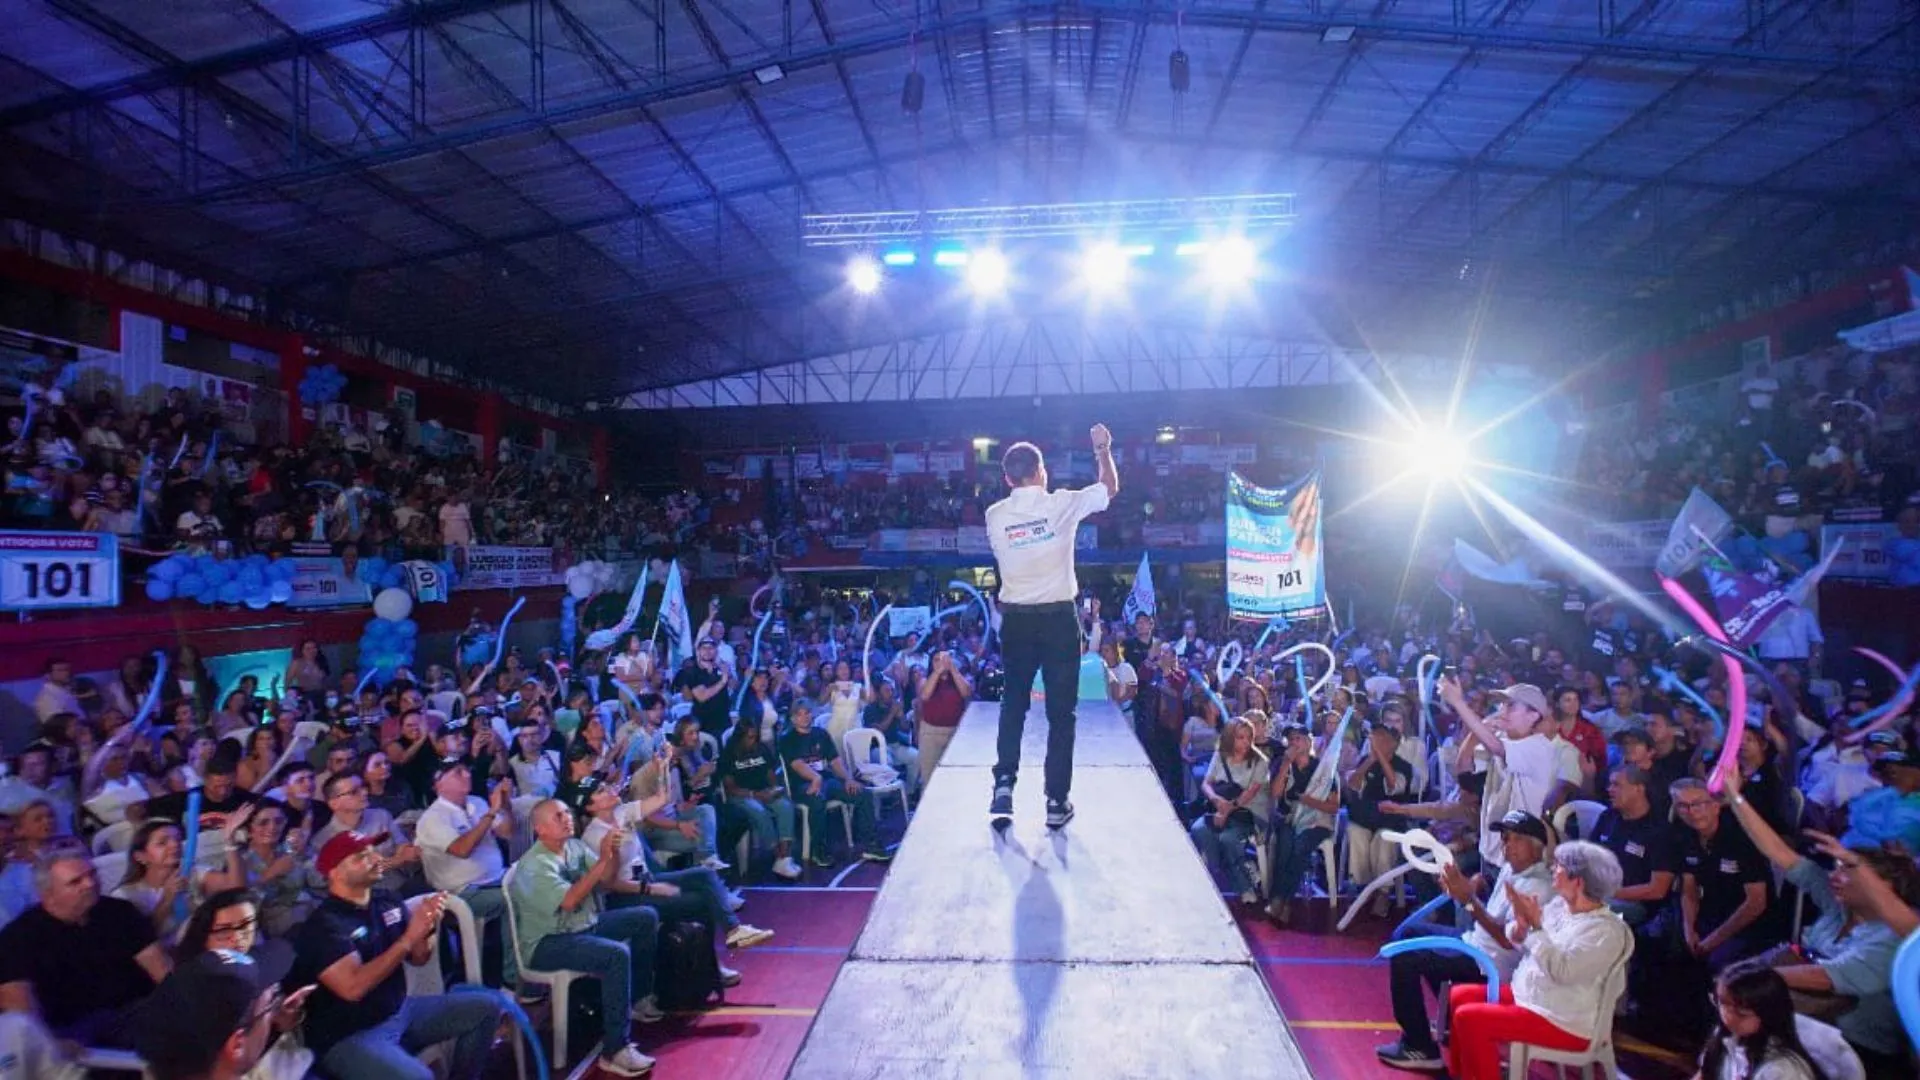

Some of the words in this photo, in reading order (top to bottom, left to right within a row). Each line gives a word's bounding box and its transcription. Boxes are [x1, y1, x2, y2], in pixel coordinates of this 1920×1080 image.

[1667, 538, 1694, 565] 101
[22, 562, 91, 599] 101
[319, 579, 337, 593] 101
[1278, 570, 1302, 589] 101
